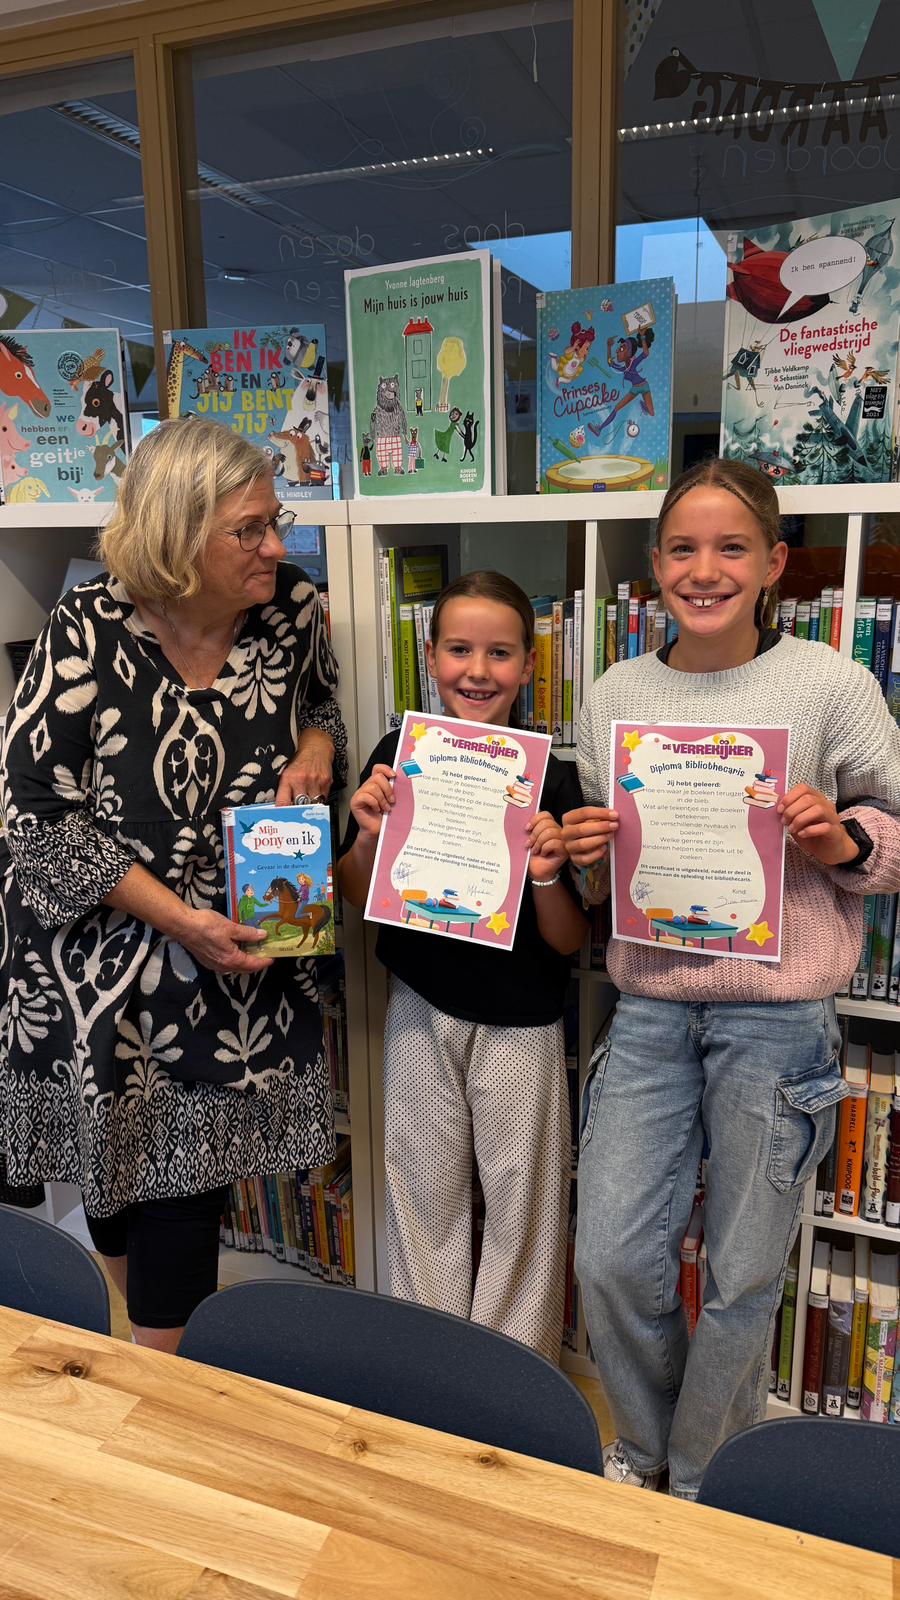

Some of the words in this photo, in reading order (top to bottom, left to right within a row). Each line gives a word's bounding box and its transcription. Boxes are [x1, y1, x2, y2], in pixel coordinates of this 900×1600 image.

[818, 256, 856, 270] spannend!
[385, 279, 407, 290] Yvonne
[409, 274, 445, 287] Jagtenberg
[363, 298, 384, 315] Mijn
[387, 295, 407, 309] huis
[410, 294, 418, 307] is
[421, 292, 444, 309] jouw
[448, 287, 469, 301] huis
[780, 328, 797, 342] De
[801, 317, 878, 340] fantastische
[233, 328, 257, 350] IK
[784, 332, 871, 359] vliegwedstrijd
[210, 350, 253, 373] BEN
[259, 348, 283, 370] IK
[765, 367, 781, 377] Tjibbe
[782, 364, 809, 373] Veldkamp
[779, 373, 809, 382] Sebastiaan
[241, 373, 262, 389] EN
[785, 382, 808, 390] Doninck
[562, 382, 600, 401] Prinses
[197, 390, 234, 413] JIJ
[241, 388, 296, 411] BENT
[553, 382, 620, 421] Cupcake
[56, 414, 75, 423] we
[232, 413, 269, 435] JIJ
[21, 425, 56, 433] hebben
[37, 435, 69, 445] een
[30, 448, 86, 468] geitje
[57, 467, 84, 483] bij!
[286, 490, 312, 498] HINDLEY
[662, 743, 672, 751] DE
[429, 754, 458, 764] Diploma
[460, 755, 509, 777] Bibliothecaris
[650, 761, 682, 775] Diploma
[685, 760, 746, 777] Bibliothecaris
[449, 771, 463, 779] hebt
[259, 826, 278, 835] Mijn
[254, 835, 285, 850] pony
[286, 837, 299, 845] en
[302, 831, 315, 845] ik
[671, 845, 694, 853] helpen
[680, 873, 704, 881] opleiding
[849, 1104, 857, 1132] HARRELL
[845, 1159, 853, 1190] KNIPOOG
